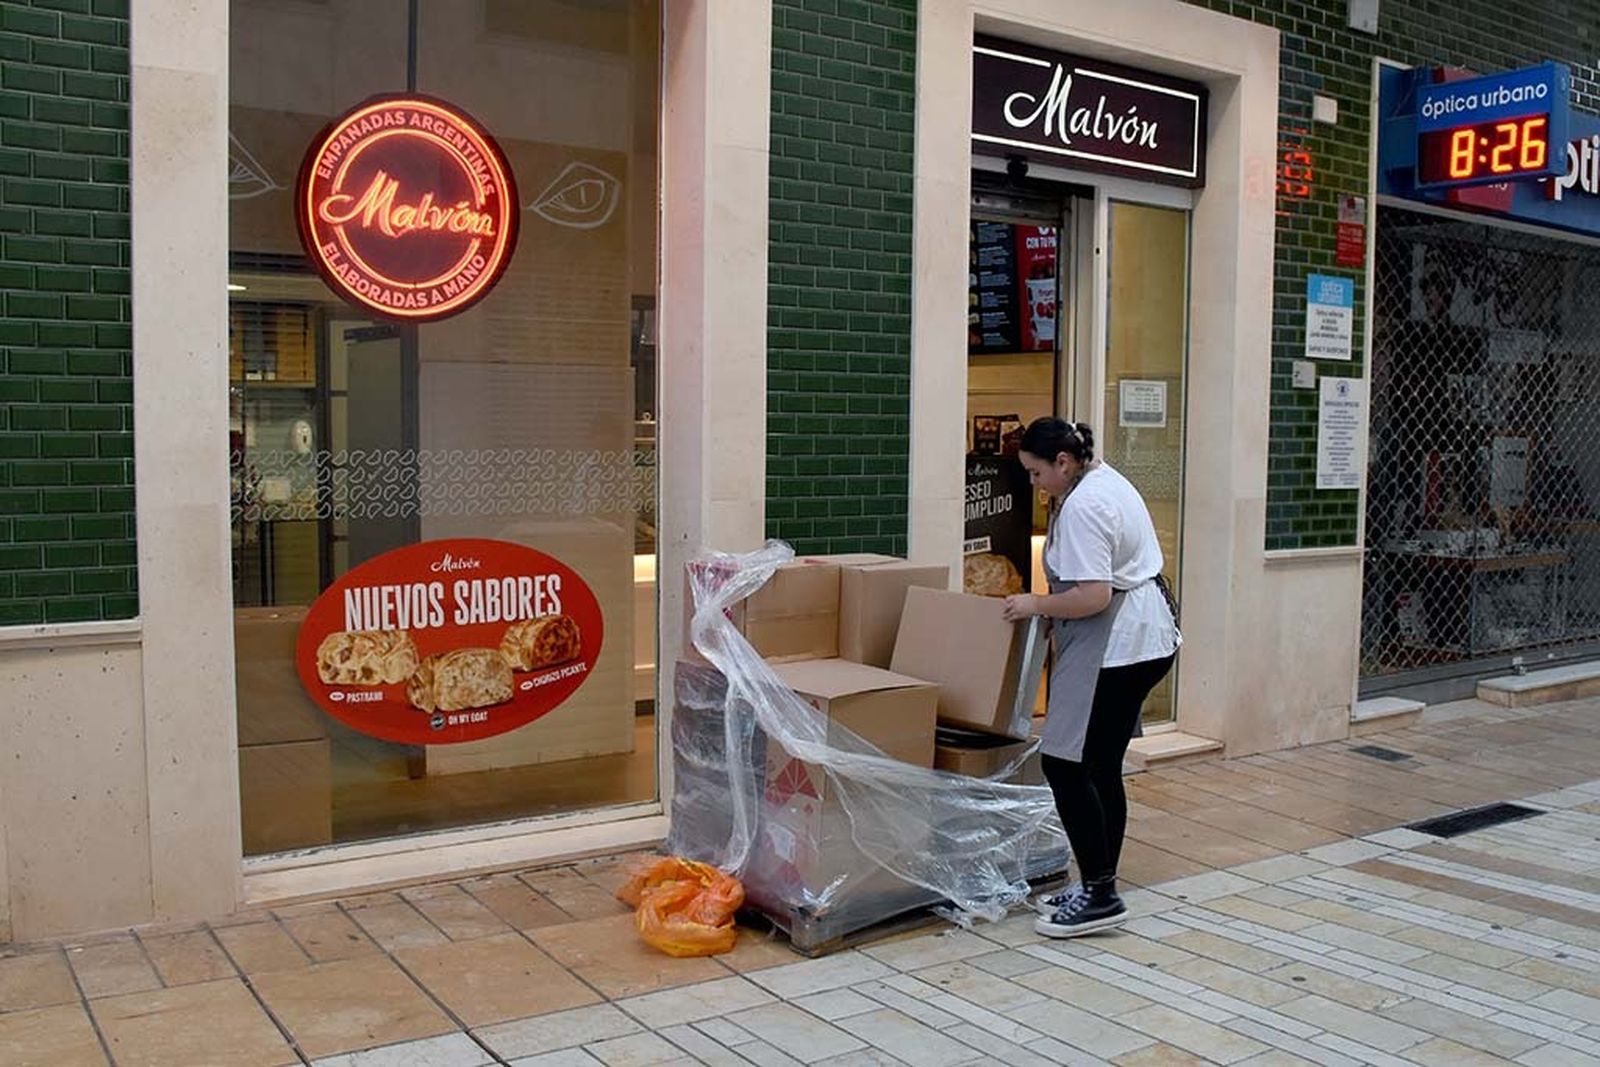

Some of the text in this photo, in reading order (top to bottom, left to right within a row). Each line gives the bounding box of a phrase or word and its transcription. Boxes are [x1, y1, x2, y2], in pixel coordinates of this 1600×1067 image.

[1003, 63, 1158, 149] Malvón
[1421, 83, 1548, 119] óptica urbano
[317, 111, 496, 197] EMPANADAS ARGENTINAS
[1450, 118, 1546, 178] 8:26
[319, 169, 496, 238] Malvón
[321, 242, 486, 309] ELABORADAS A MANO
[344, 574, 562, 632] NUEVOS SABORES
